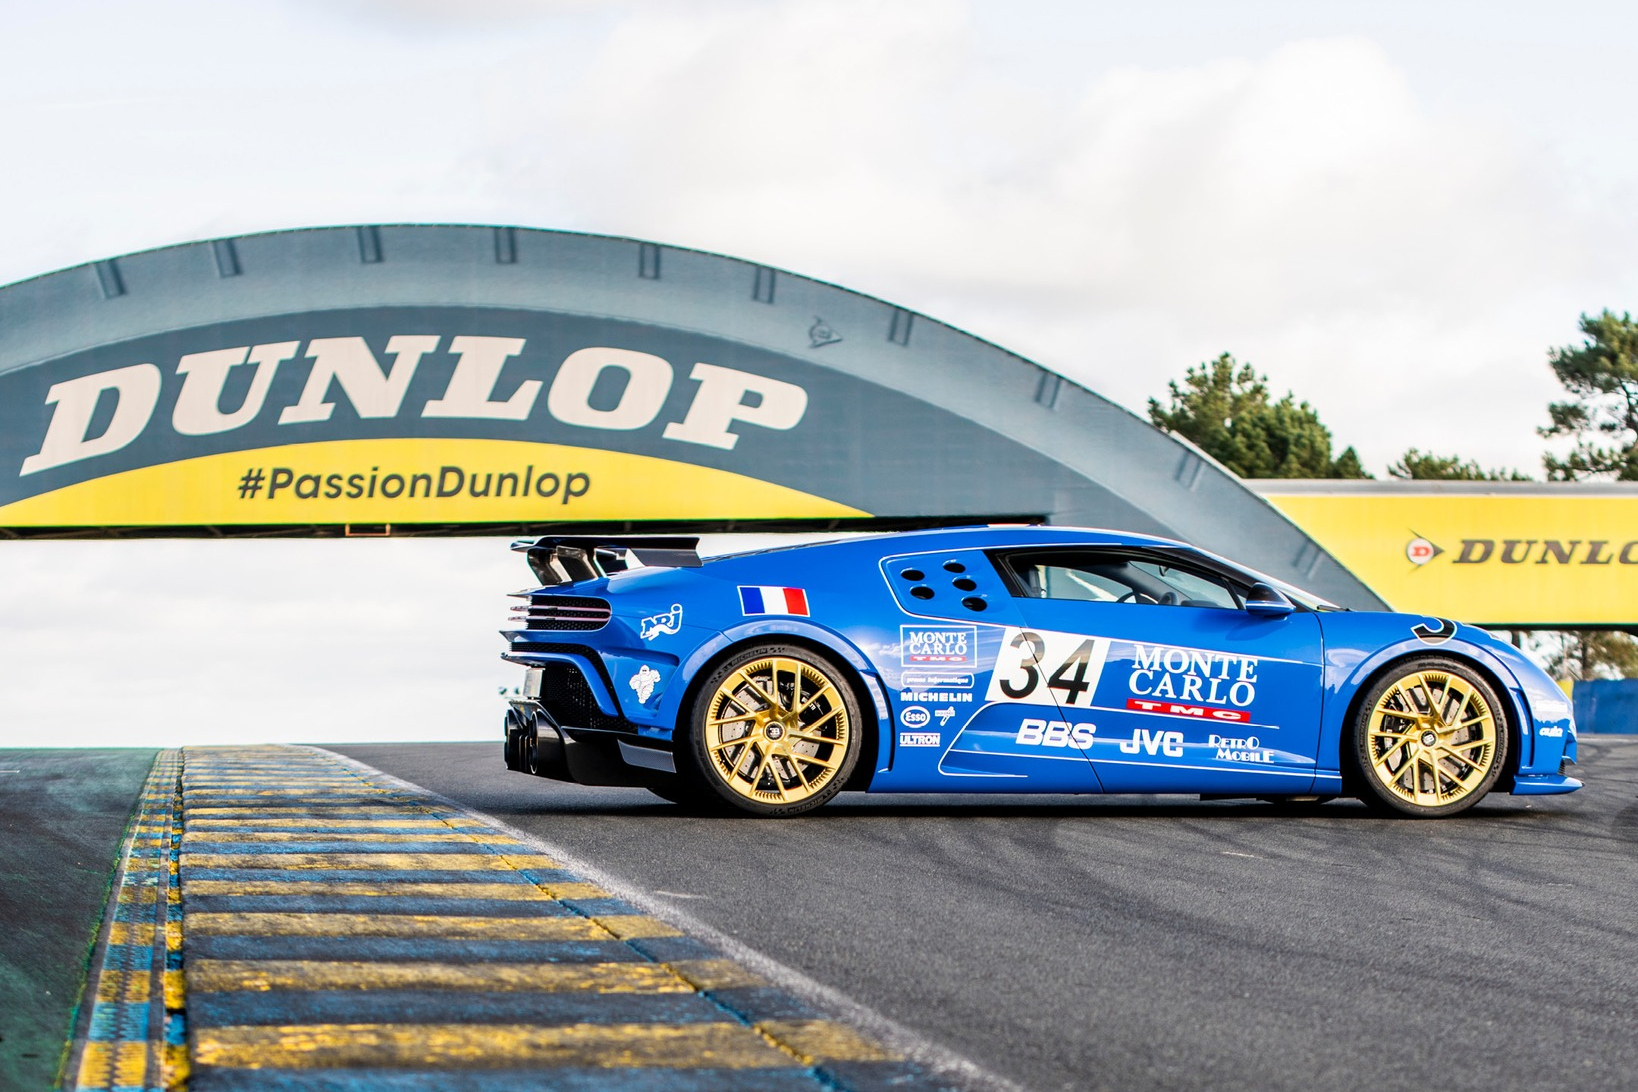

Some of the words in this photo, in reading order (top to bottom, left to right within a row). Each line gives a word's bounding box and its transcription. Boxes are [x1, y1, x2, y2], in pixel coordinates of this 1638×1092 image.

[19, 334, 808, 477] DUNLOP
[238, 465, 590, 505] #PassionDunlop
[909, 631, 967, 644] MONTE
[909, 643, 967, 655] CARLO
[1000, 631, 1096, 705] 34
[1132, 644, 1259, 683] MONTE
[900, 692, 973, 702] MICHELIN
[1129, 669, 1256, 707] CARLO
[1134, 700, 1242, 720] TMC
[900, 735, 940, 745] ULTRON
[1016, 718, 1097, 749] BBS
[1120, 729, 1184, 757] JVC
[1208, 734, 1259, 749] RETRO
[1215, 748, 1275, 764] MOBILE
